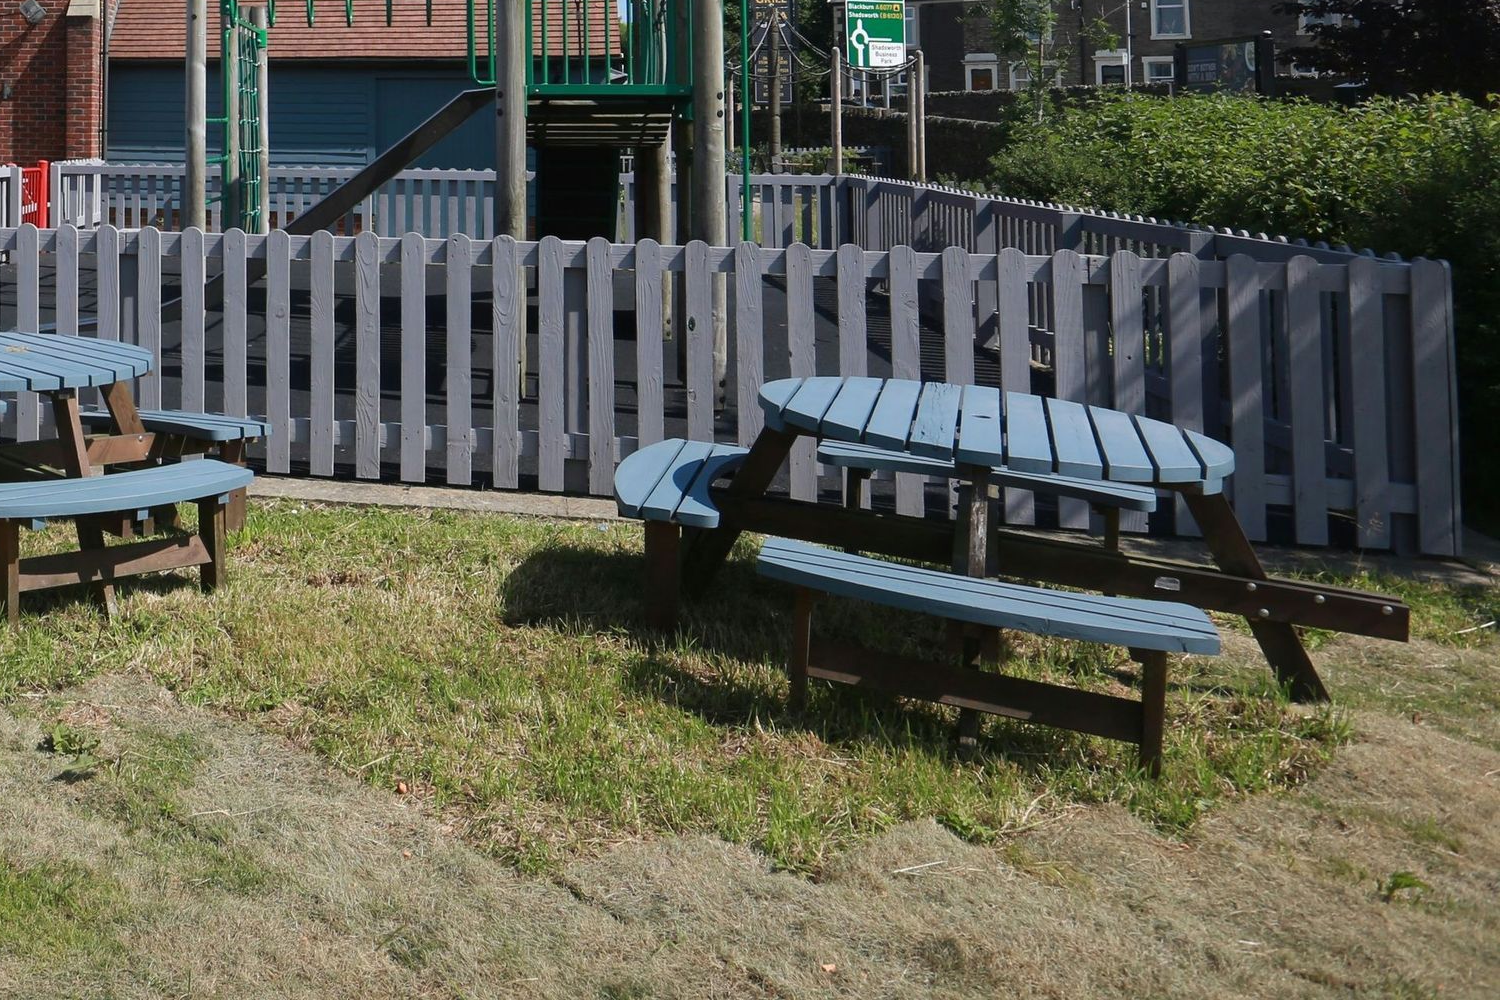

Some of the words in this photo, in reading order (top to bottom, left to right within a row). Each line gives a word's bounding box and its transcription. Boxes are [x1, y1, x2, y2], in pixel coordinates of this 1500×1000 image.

[848, 2, 875, 10] Blackburn
[848, 11, 879, 19] Shadsworth
[875, 50, 898, 58] Business
